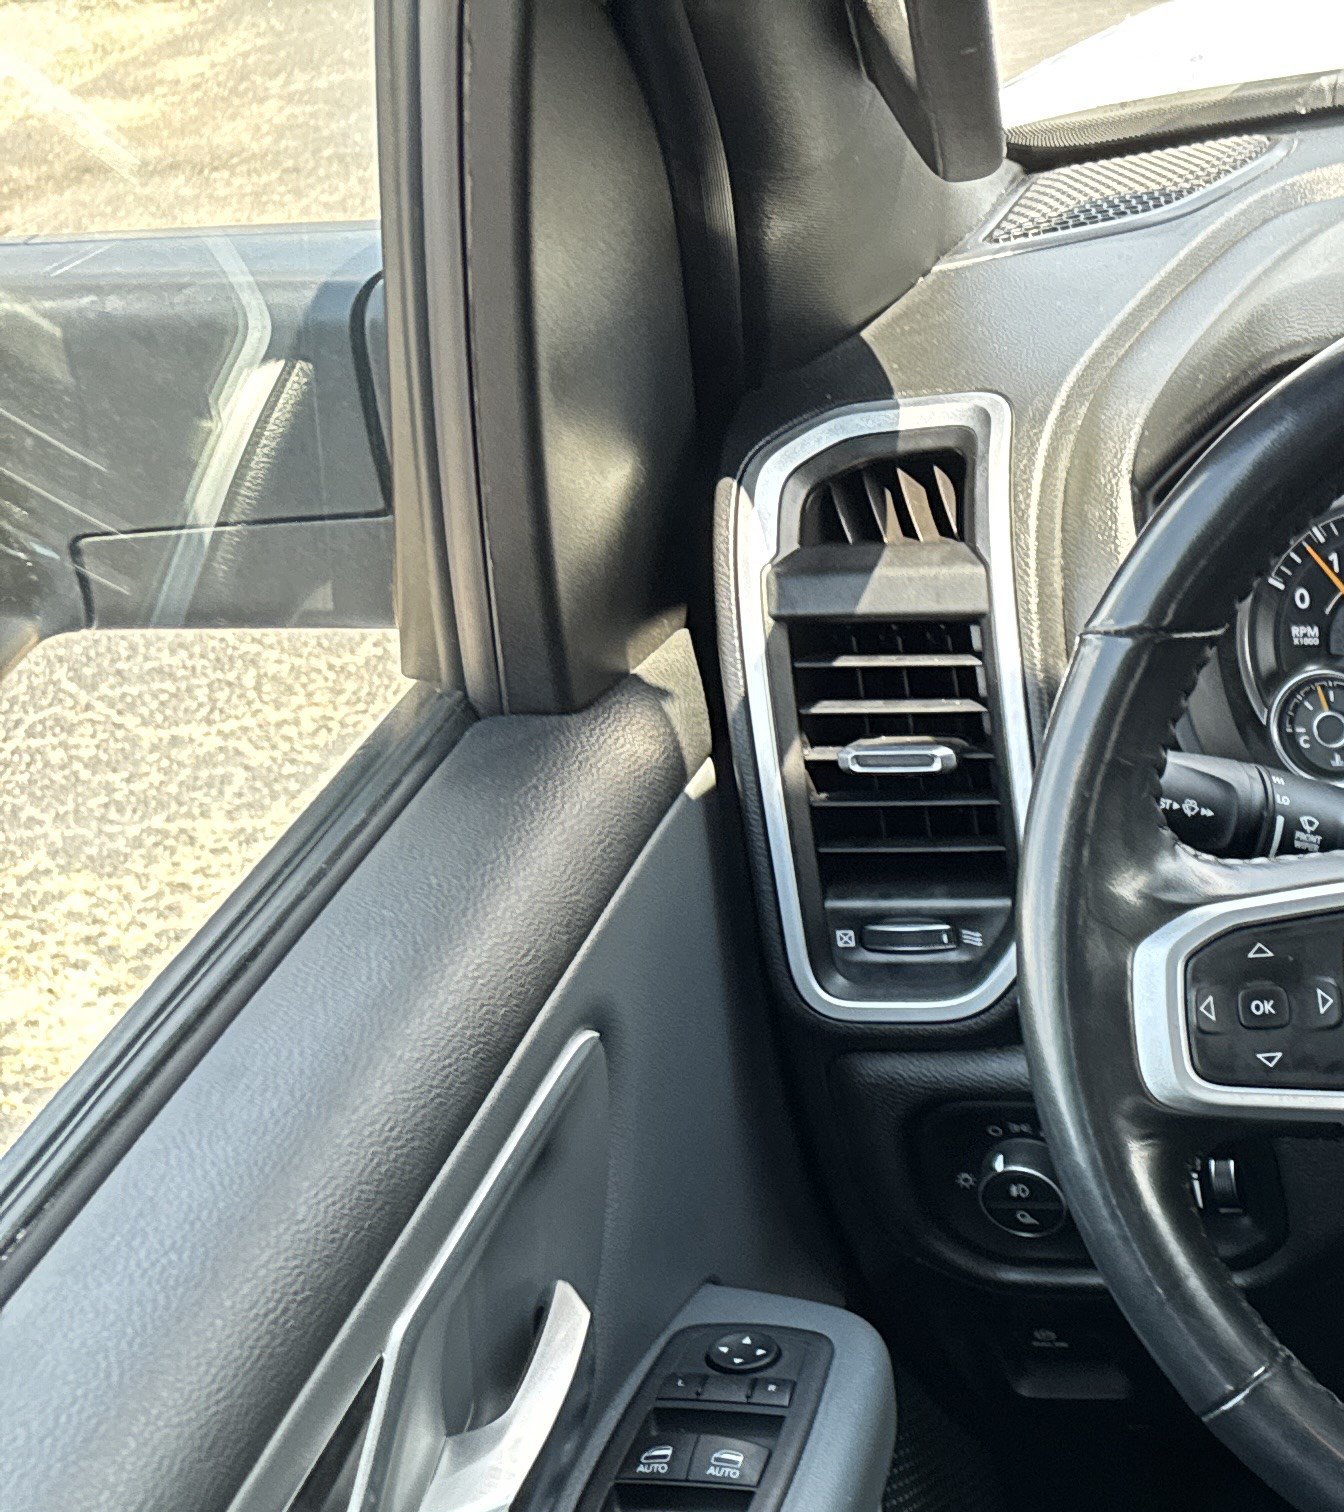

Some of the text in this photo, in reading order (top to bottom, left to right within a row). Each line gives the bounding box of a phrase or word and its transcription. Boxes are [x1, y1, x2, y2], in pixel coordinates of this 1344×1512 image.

[1329, 552, 1339, 572] 1
[1294, 589, 1310, 609] 0
[1291, 625, 1319, 638] RPM
[1300, 735, 1310, 748] C
[1251, 1000, 1275, 1015] OK
[636, 1463, 668, 1474] AUTO
[706, 1466, 740, 1479] AUTO
